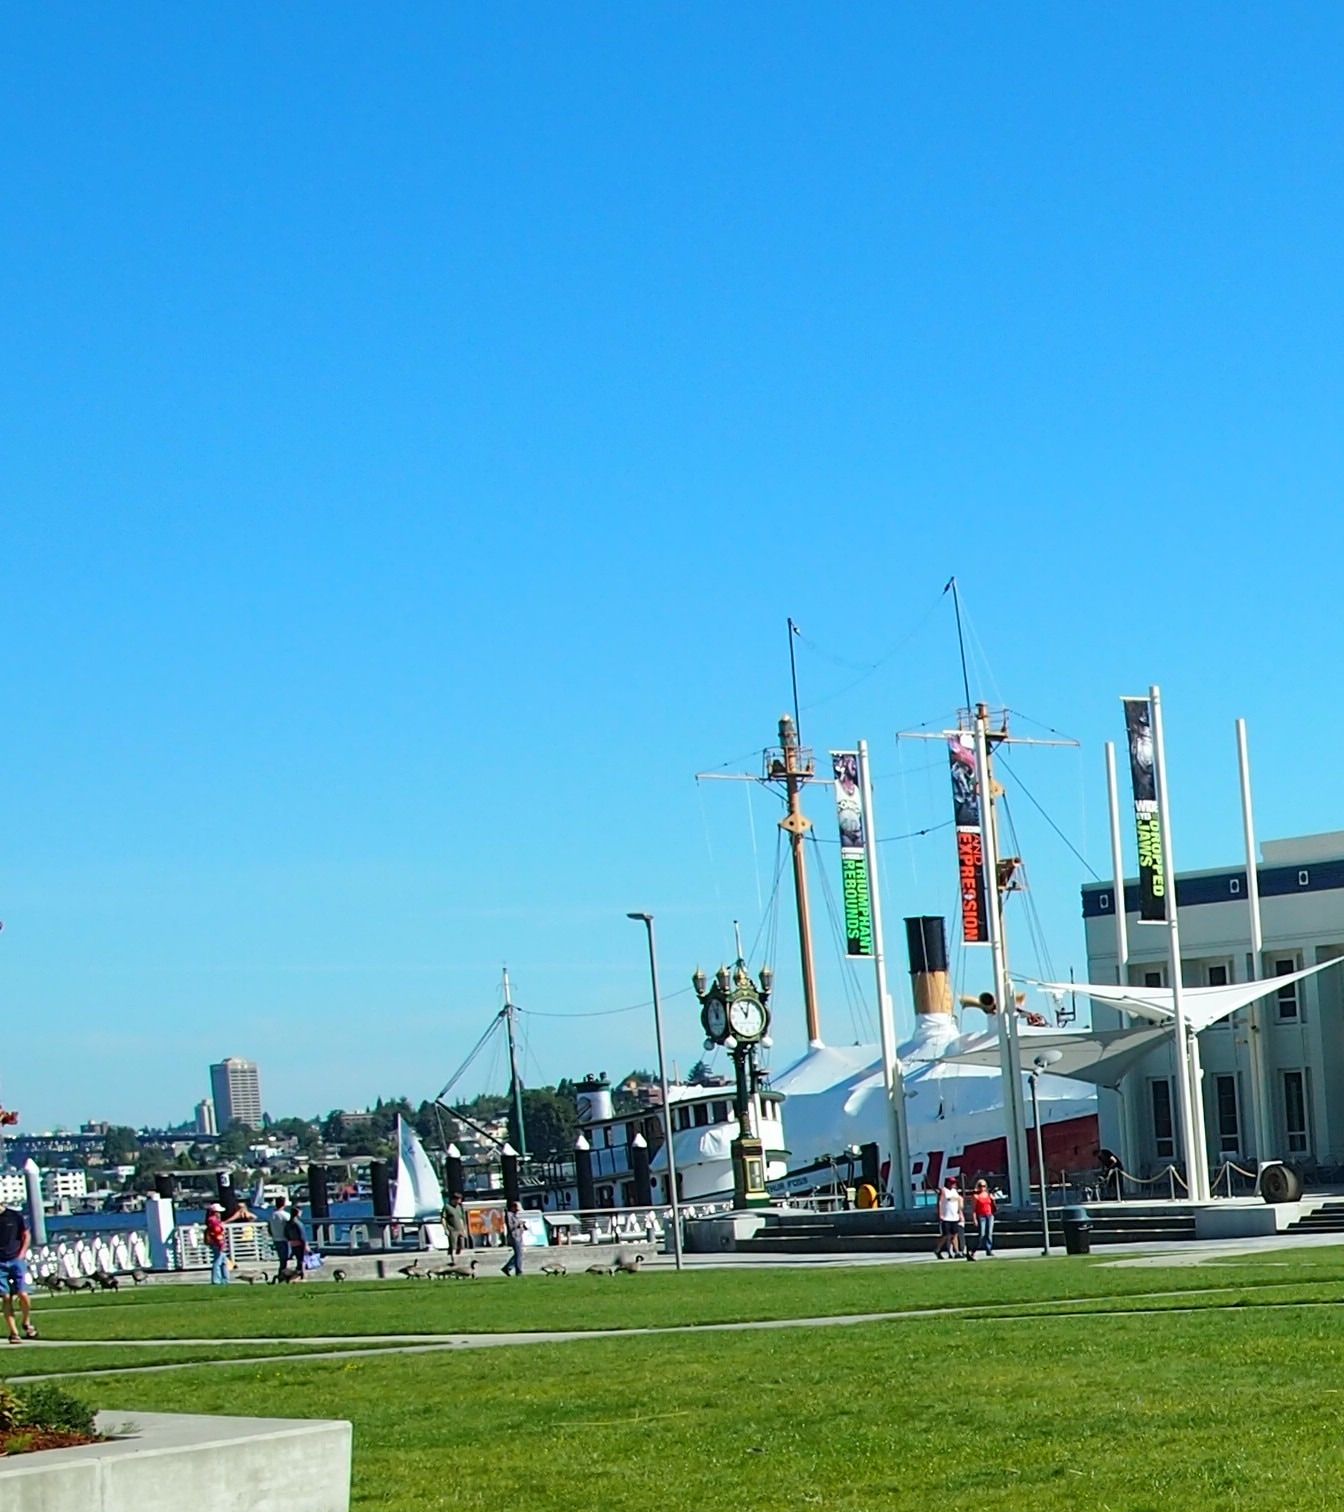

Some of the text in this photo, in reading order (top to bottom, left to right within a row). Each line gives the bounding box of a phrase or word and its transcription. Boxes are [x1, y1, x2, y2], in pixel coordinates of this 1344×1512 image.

[1137, 820, 1152, 867] JAWS
[1150, 820, 1164, 896] DROPPED
[843, 860, 859, 939] REBOUNDS
[855, 860, 871, 954] TRIUMPHANT
